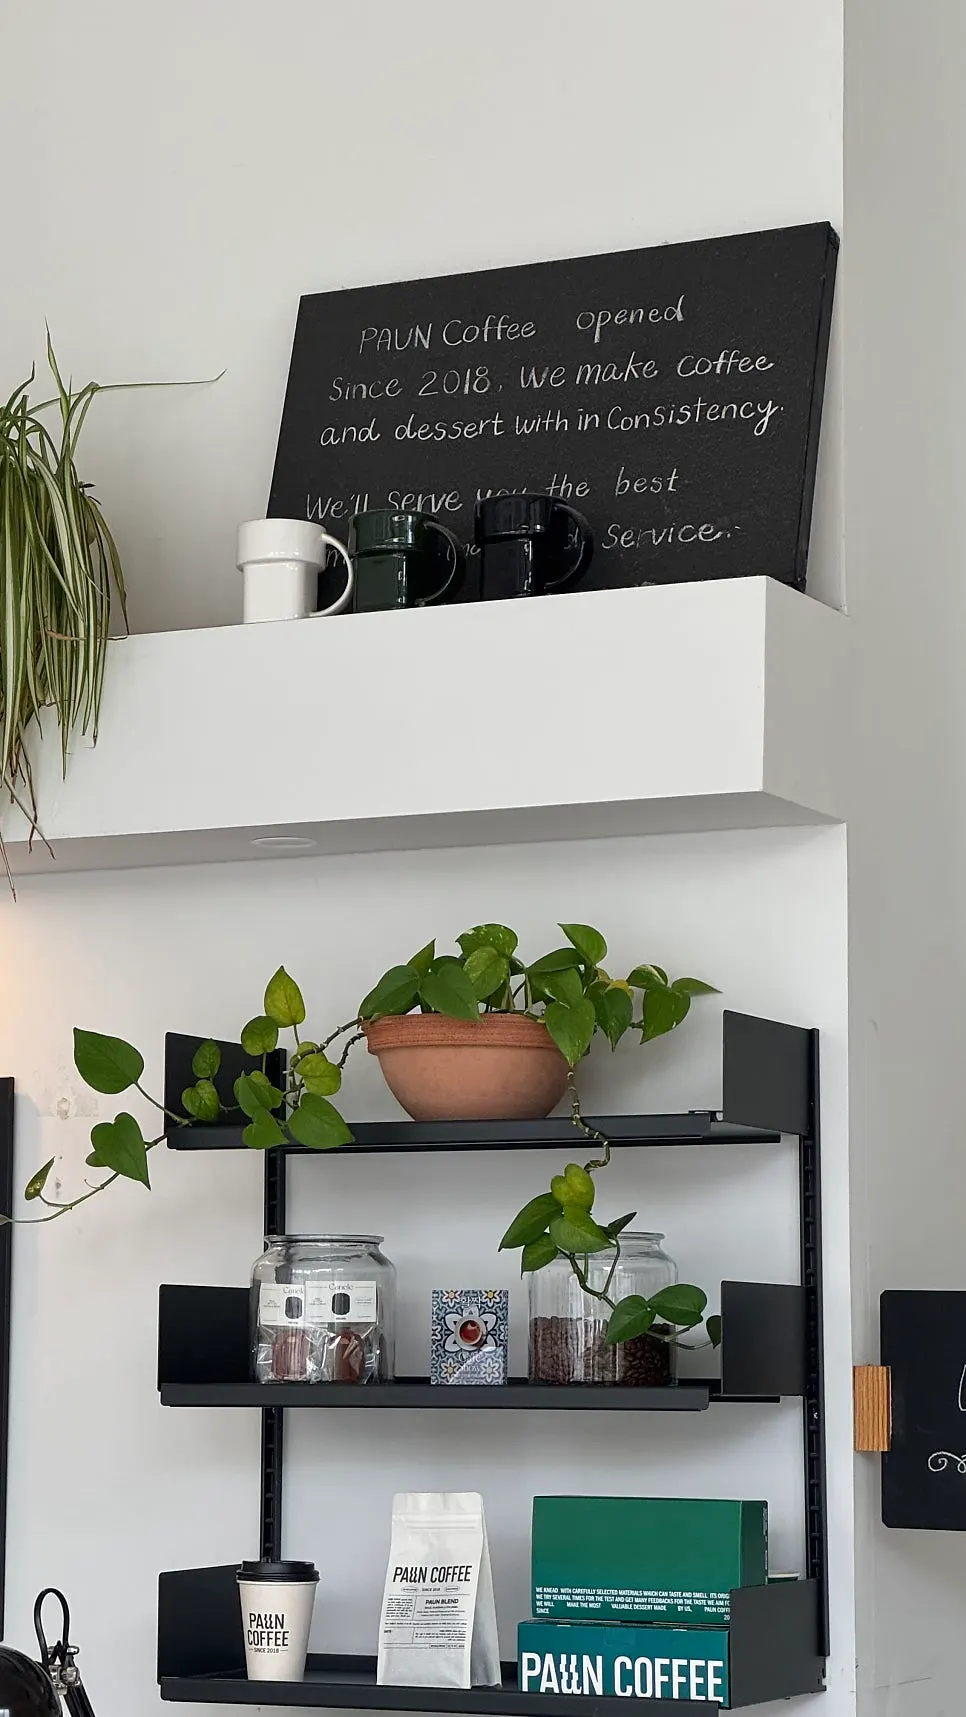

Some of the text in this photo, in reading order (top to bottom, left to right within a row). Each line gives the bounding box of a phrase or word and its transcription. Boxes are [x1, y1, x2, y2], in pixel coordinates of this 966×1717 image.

[359, 294, 685, 354] PAUN Coffee opened
[328, 376, 403, 402] Since
[575, 351, 659, 385] make
[677, 349, 775, 377] coffee
[319, 417, 381, 446] and
[394, 413, 505, 442] dessert
[576, 407, 600, 431] in
[306, 492, 369, 520] We'll
[545, 473, 591, 499] the
[614, 466, 679, 497] best
[392, 1565, 473, 1584] PAUN COFFEE
[247, 1629, 290, 1647] COFFEE
[248, 1612, 285, 1630] PAUN
[521, 1651, 724, 1703] PAUN COFFEE
